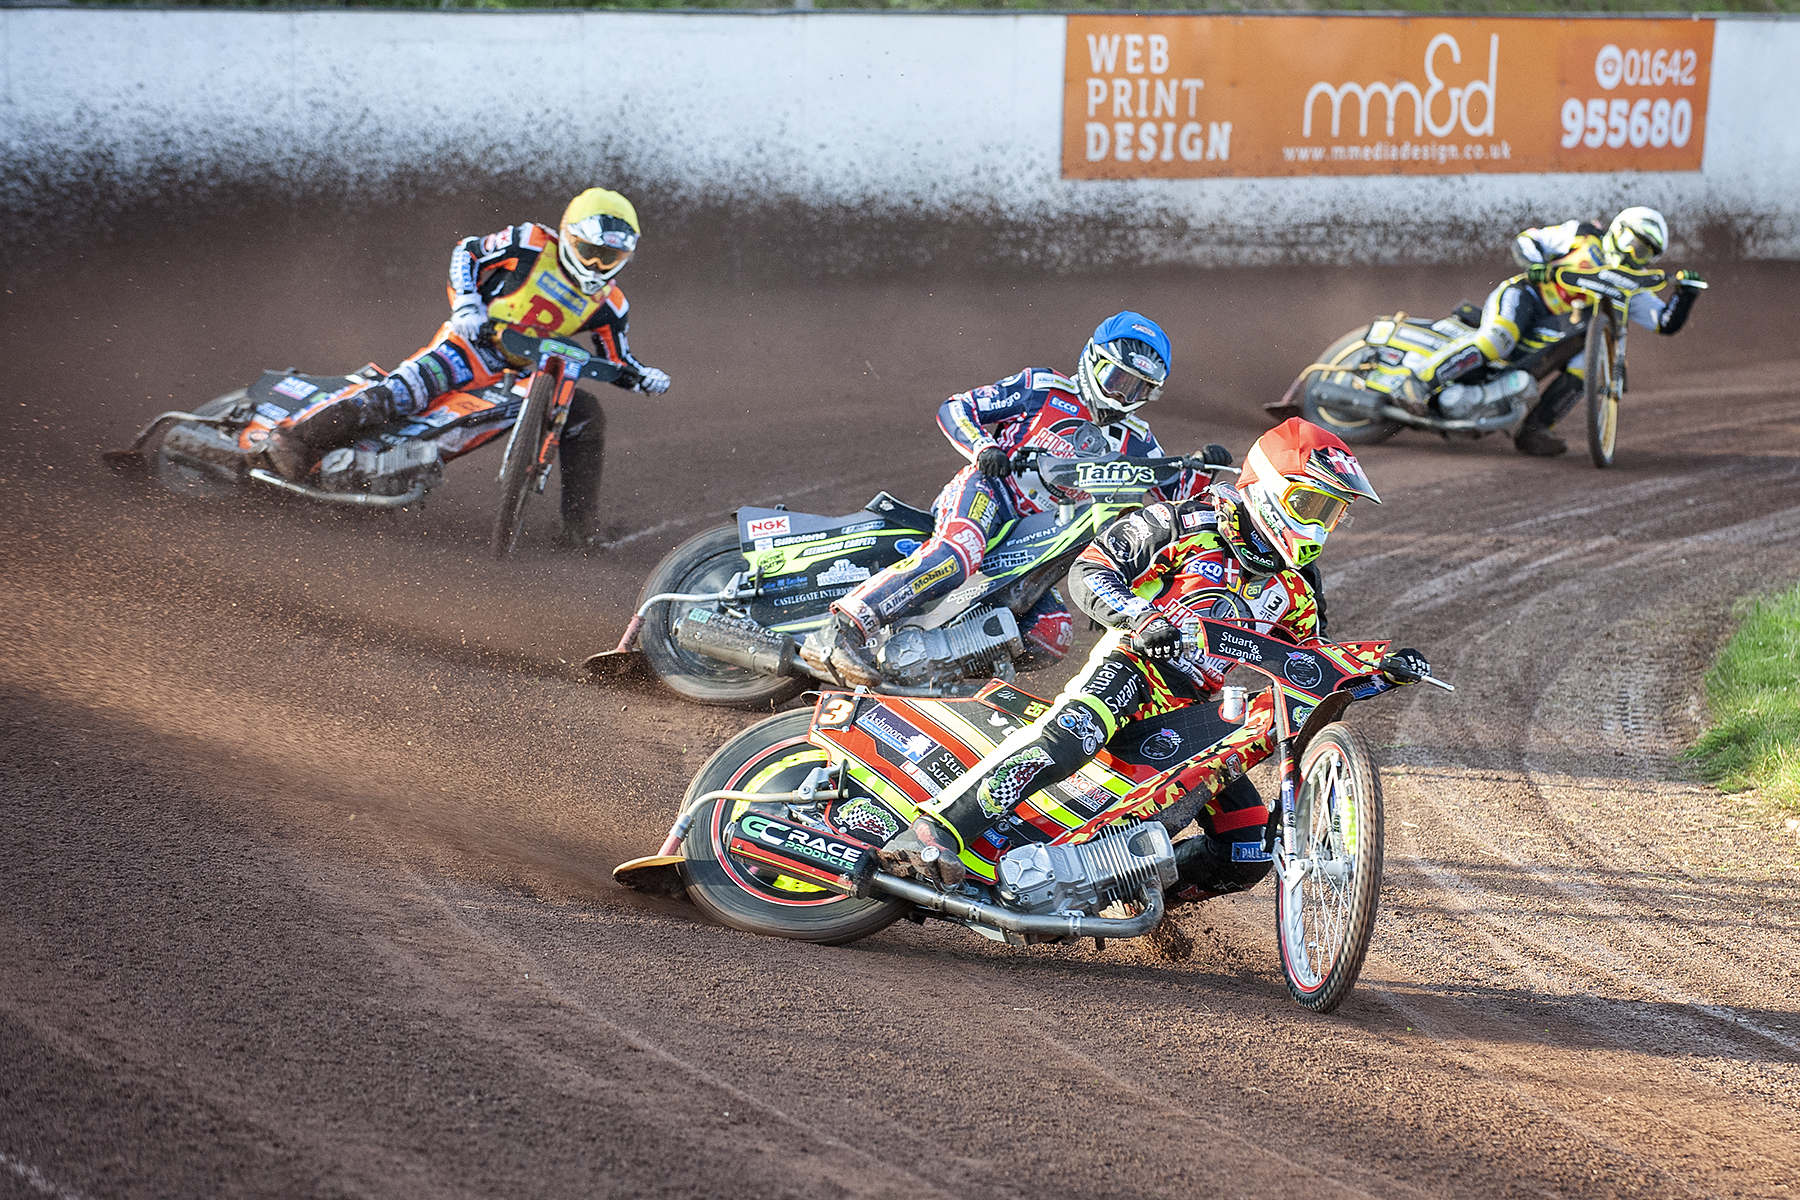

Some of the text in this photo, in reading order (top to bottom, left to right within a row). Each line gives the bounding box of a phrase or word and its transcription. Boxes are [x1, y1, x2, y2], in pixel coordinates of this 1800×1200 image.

[1086, 34, 1169, 74] WEB
[1623, 48, 1697, 86] 01642
[1086, 78, 1205, 118] PRINT
[1303, 33, 1499, 138] mm&d
[1560, 97, 1692, 149] 955680
[1085, 121, 1233, 162] DESIGN
[1282, 141, 1512, 164] www.mmediadesign.co.uk
[1051, 396, 1078, 413] ECCO
[1078, 463, 1154, 485] Taffys
[751, 519, 787, 533] NGK
[1182, 514, 1196, 528] LJ
[774, 532, 828, 547] Silkolene
[1188, 560, 1224, 577] ECCO
[774, 585, 854, 607] CASTLEGATE INTERIO
[884, 561, 956, 612] Allied Mobility
[1248, 584, 1262, 596] 267
[1267, 595, 1284, 612] 3
[1218, 642, 1263, 662] Suzanne
[818, 699, 854, 725] 3
[865, 712, 909, 746] Ashmore
[902, 761, 919, 776] LJ
[927, 761, 953, 787] Suza
[939, 752, 965, 777] Stua
[1067, 773, 1110, 804] MOTIVE
[784, 841, 856, 870] PRODUCTS
[787, 829, 862, 863] RACE
